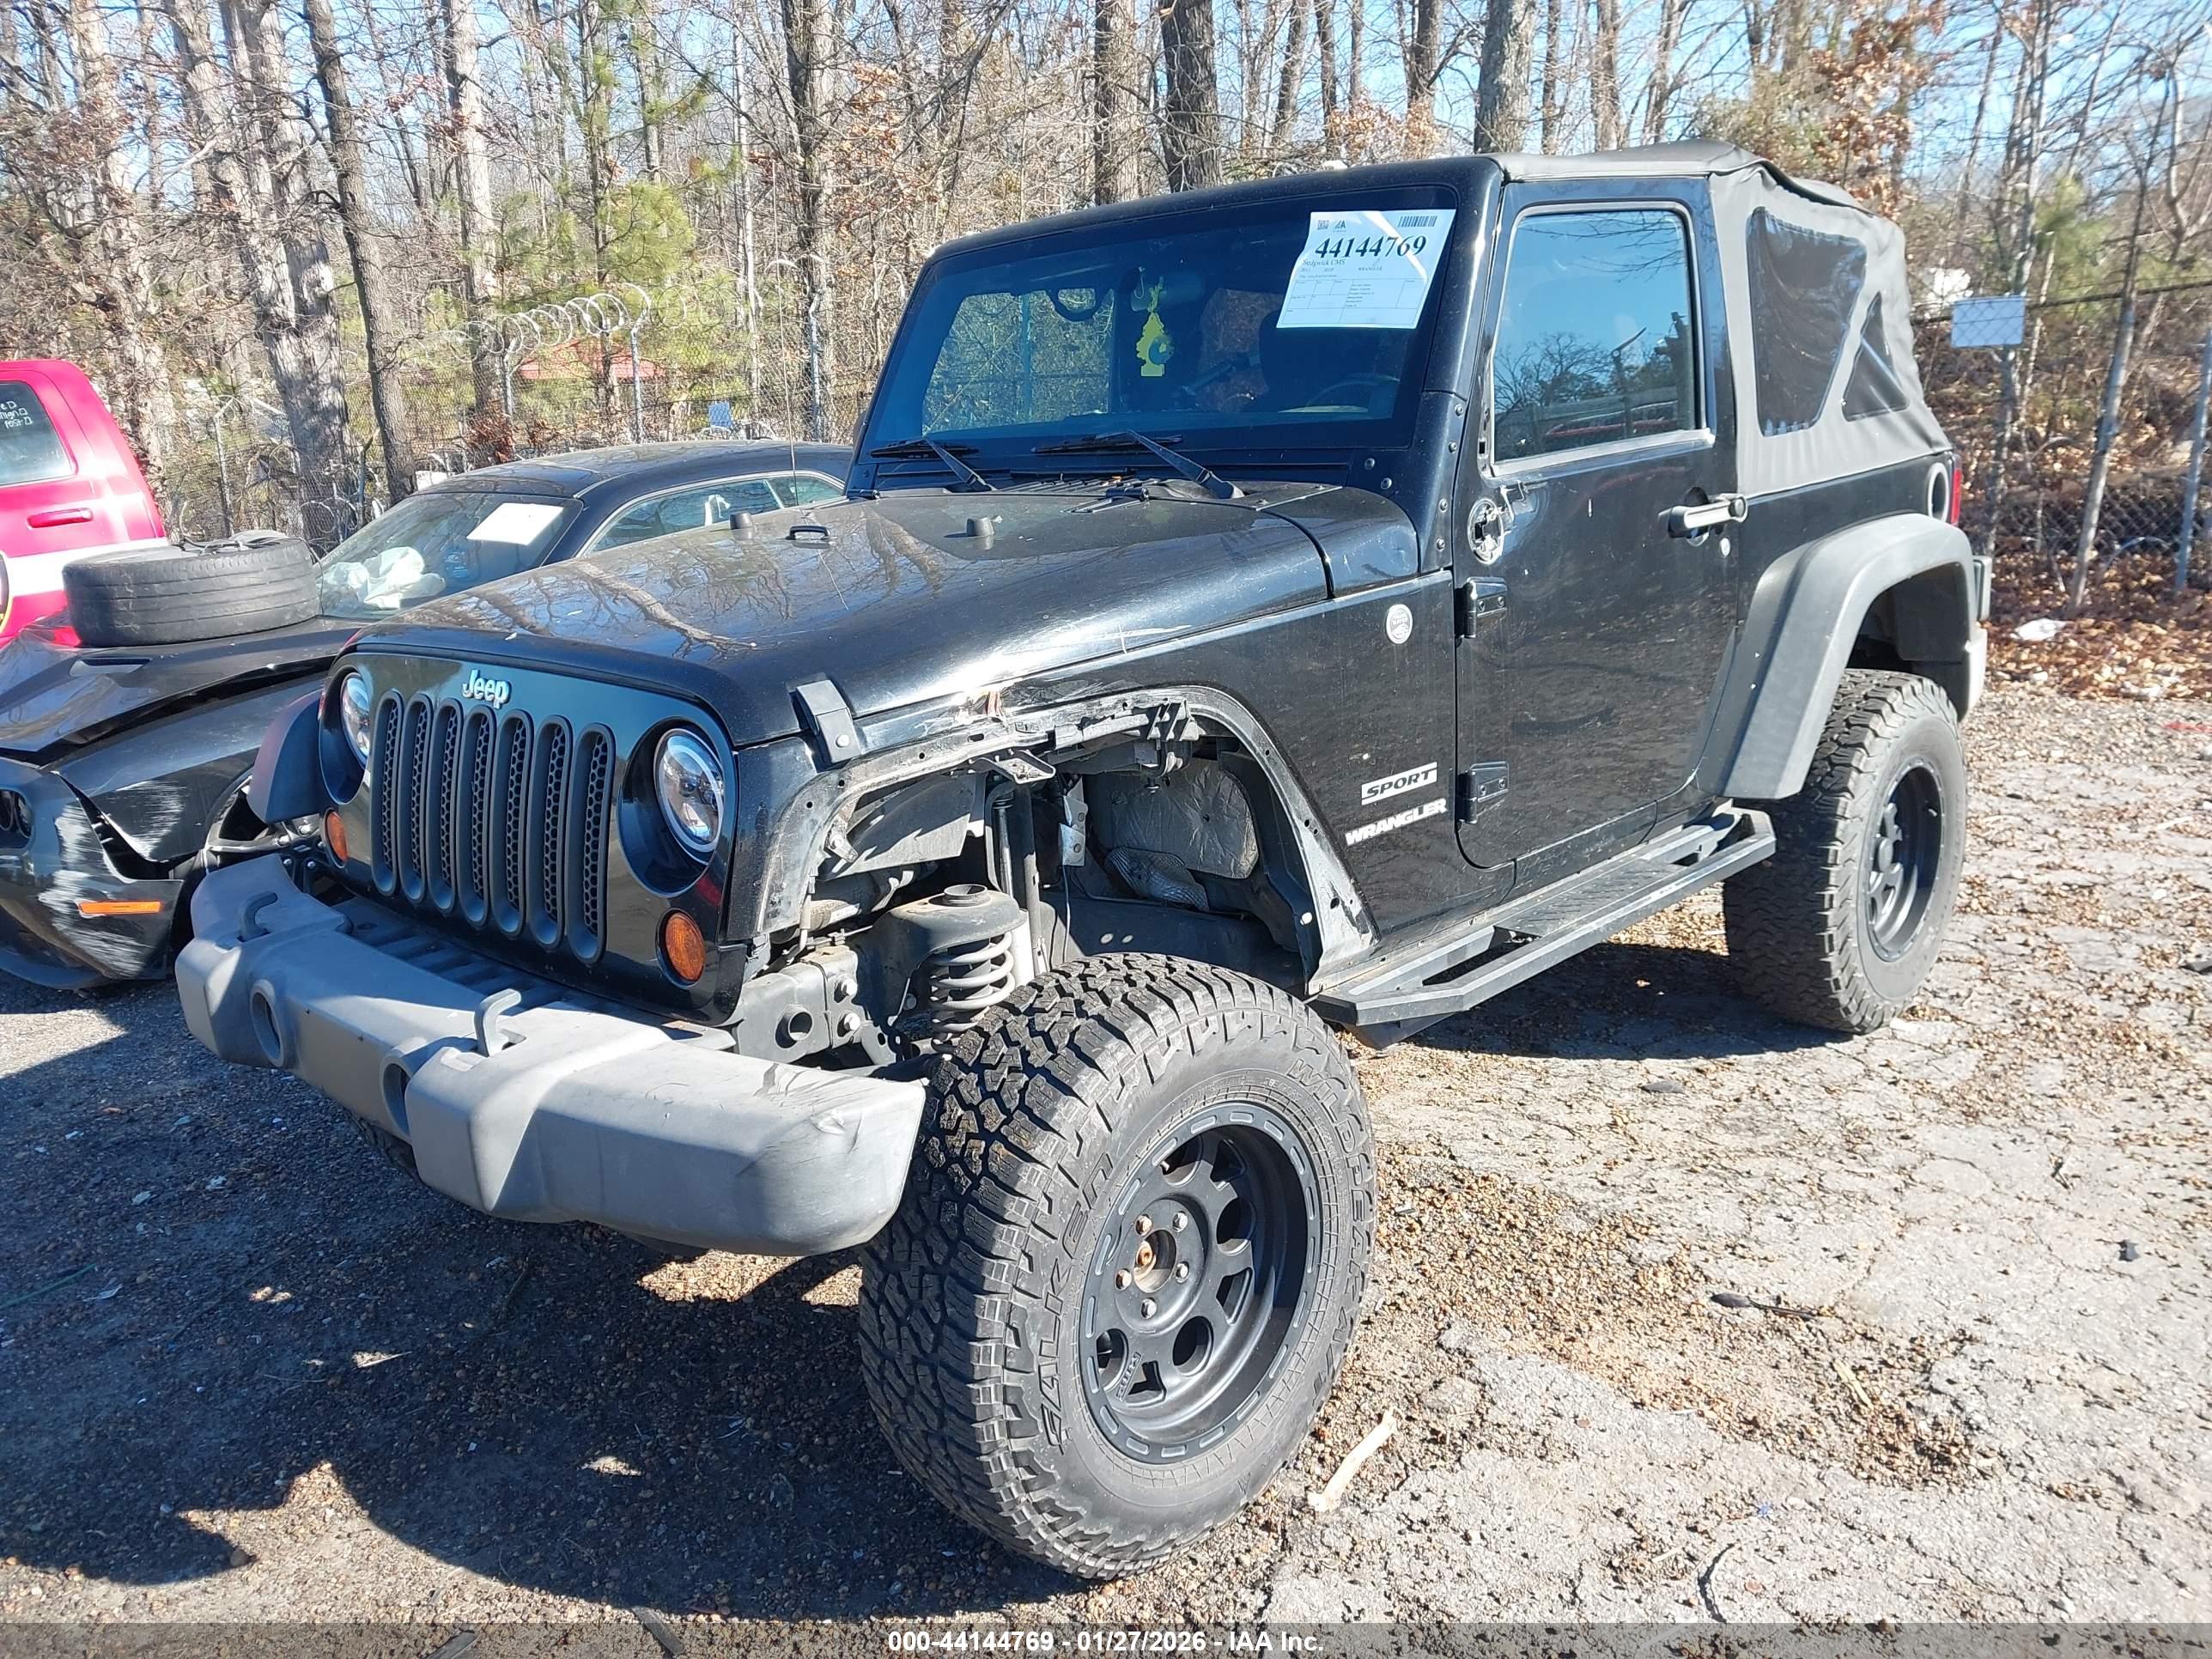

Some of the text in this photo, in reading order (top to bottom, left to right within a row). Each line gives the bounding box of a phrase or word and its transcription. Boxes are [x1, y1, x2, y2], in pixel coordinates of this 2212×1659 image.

[1303, 258, 1329, 267] Sedgwick
[1315, 234, 1427, 258] 44144769
[462, 669, 511, 710] Jeep
[1366, 770, 1431, 799] SPORT
[1345, 798, 1449, 846] WRANGLER
[1287, 1058, 1366, 1303] WILDPEAK
